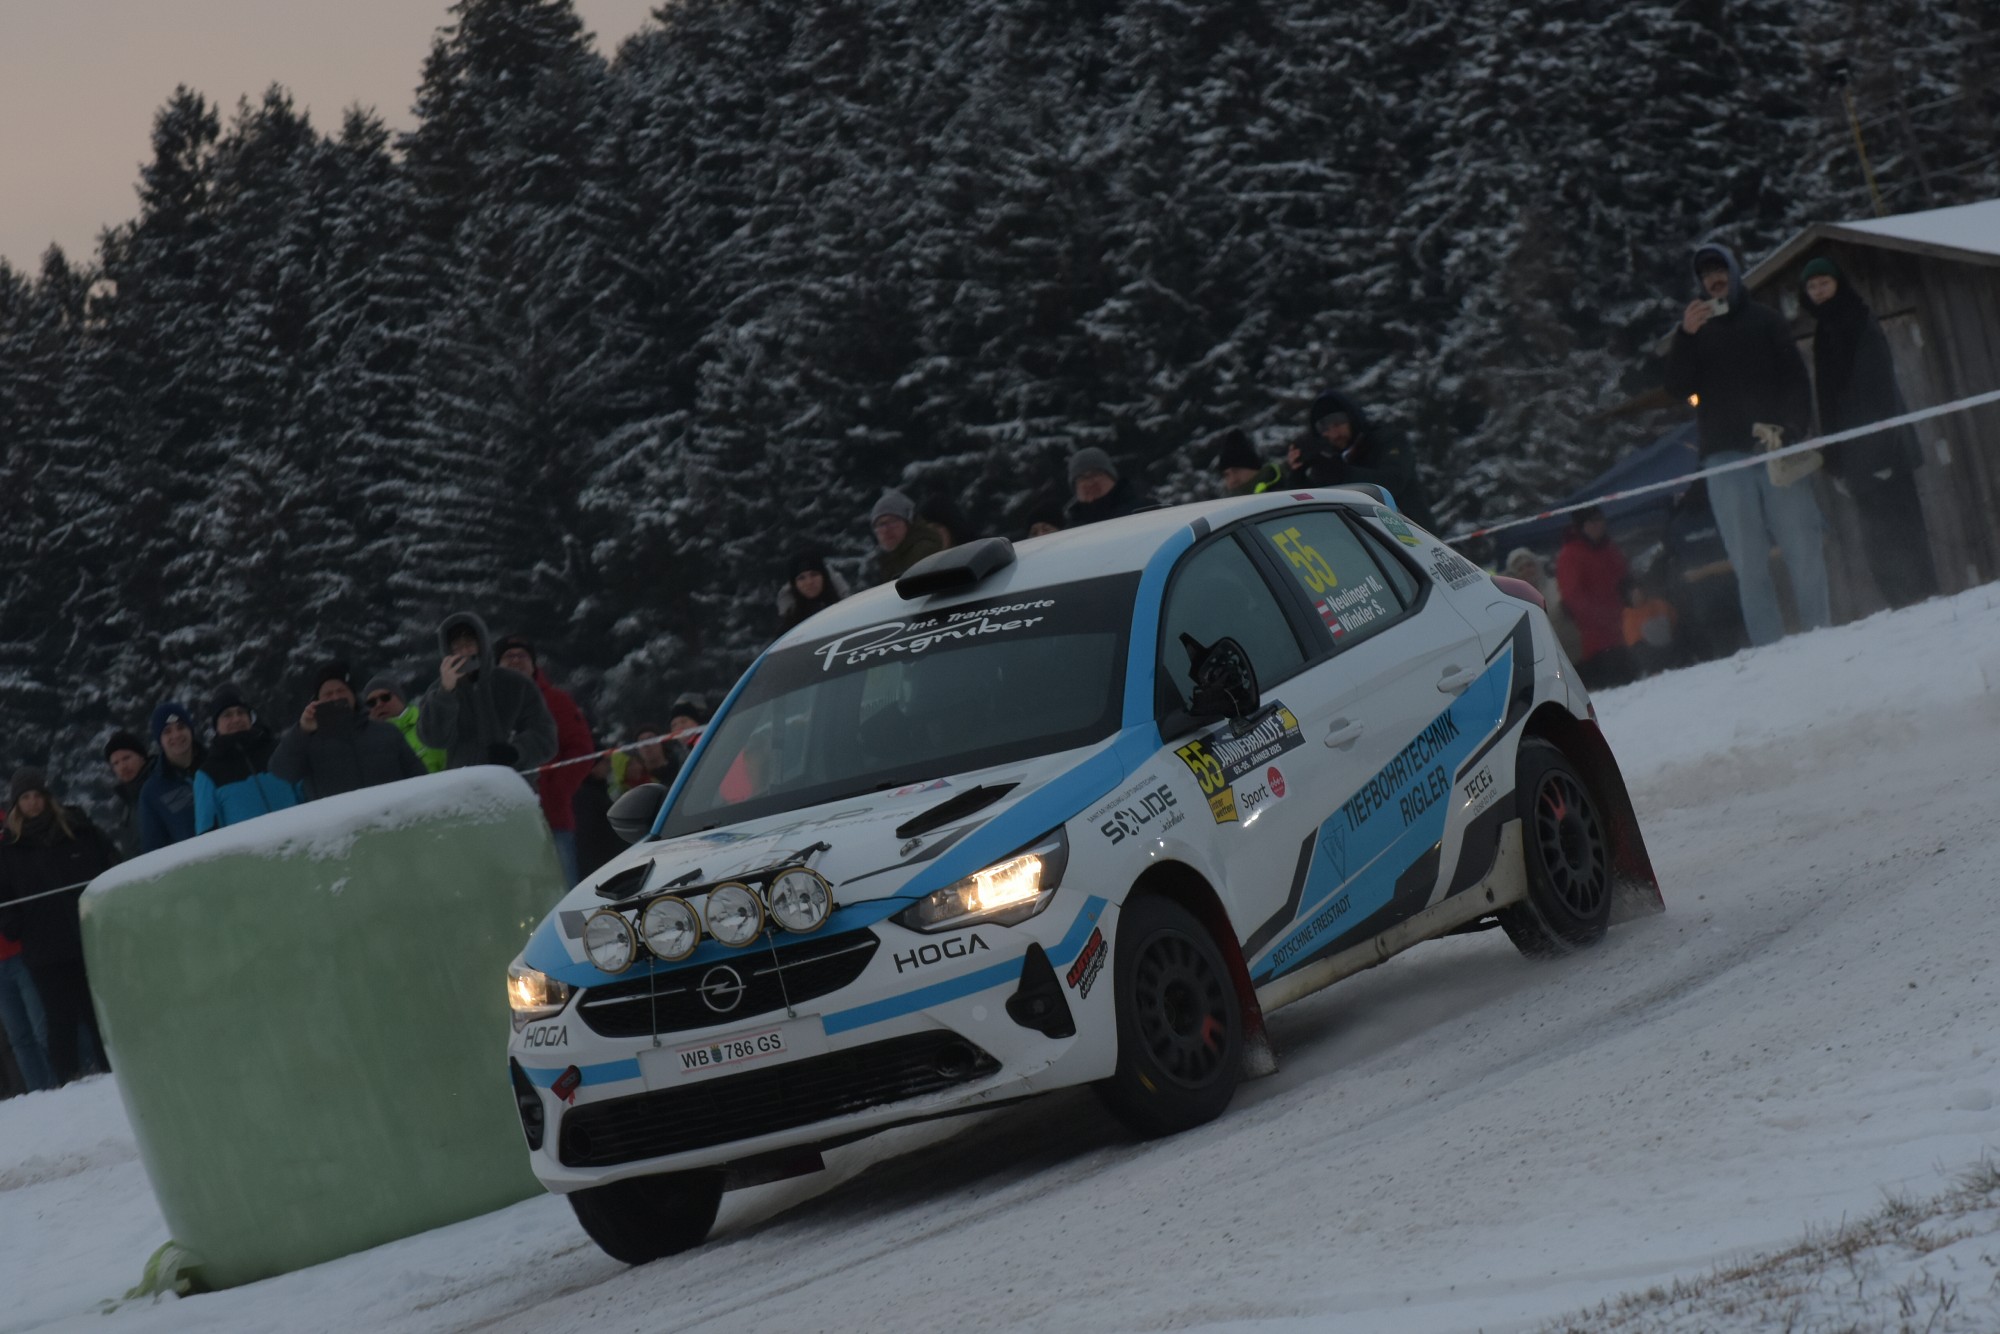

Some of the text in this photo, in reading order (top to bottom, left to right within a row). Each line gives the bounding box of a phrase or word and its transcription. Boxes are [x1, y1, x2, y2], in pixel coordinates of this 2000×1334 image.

[1271, 526, 1338, 594] 55
[1326, 575, 1384, 613] Neulinger M.
[906, 599, 1056, 632] Int. Transporte
[1338, 598, 1387, 632] Winkler S.
[814, 614, 1045, 671] Pirngruber
[1174, 740, 1226, 795] 55
[1250, 747, 1270, 767] JÄNNER
[1267, 743, 1283, 757] 2025
[1342, 709, 1461, 832] TIEFBOHRTECHNIK
[1100, 784, 1178, 846] SOLIDE
[1240, 783, 1269, 811] Sport
[1399, 763, 1450, 828] RIGLER
[1272, 893, 1352, 968] ROTSCHNE FREISTADT
[892, 933, 991, 974] HOGA
[524, 1025, 568, 1049] HOGA
[681, 1034, 782, 1068] WB 786 GS
